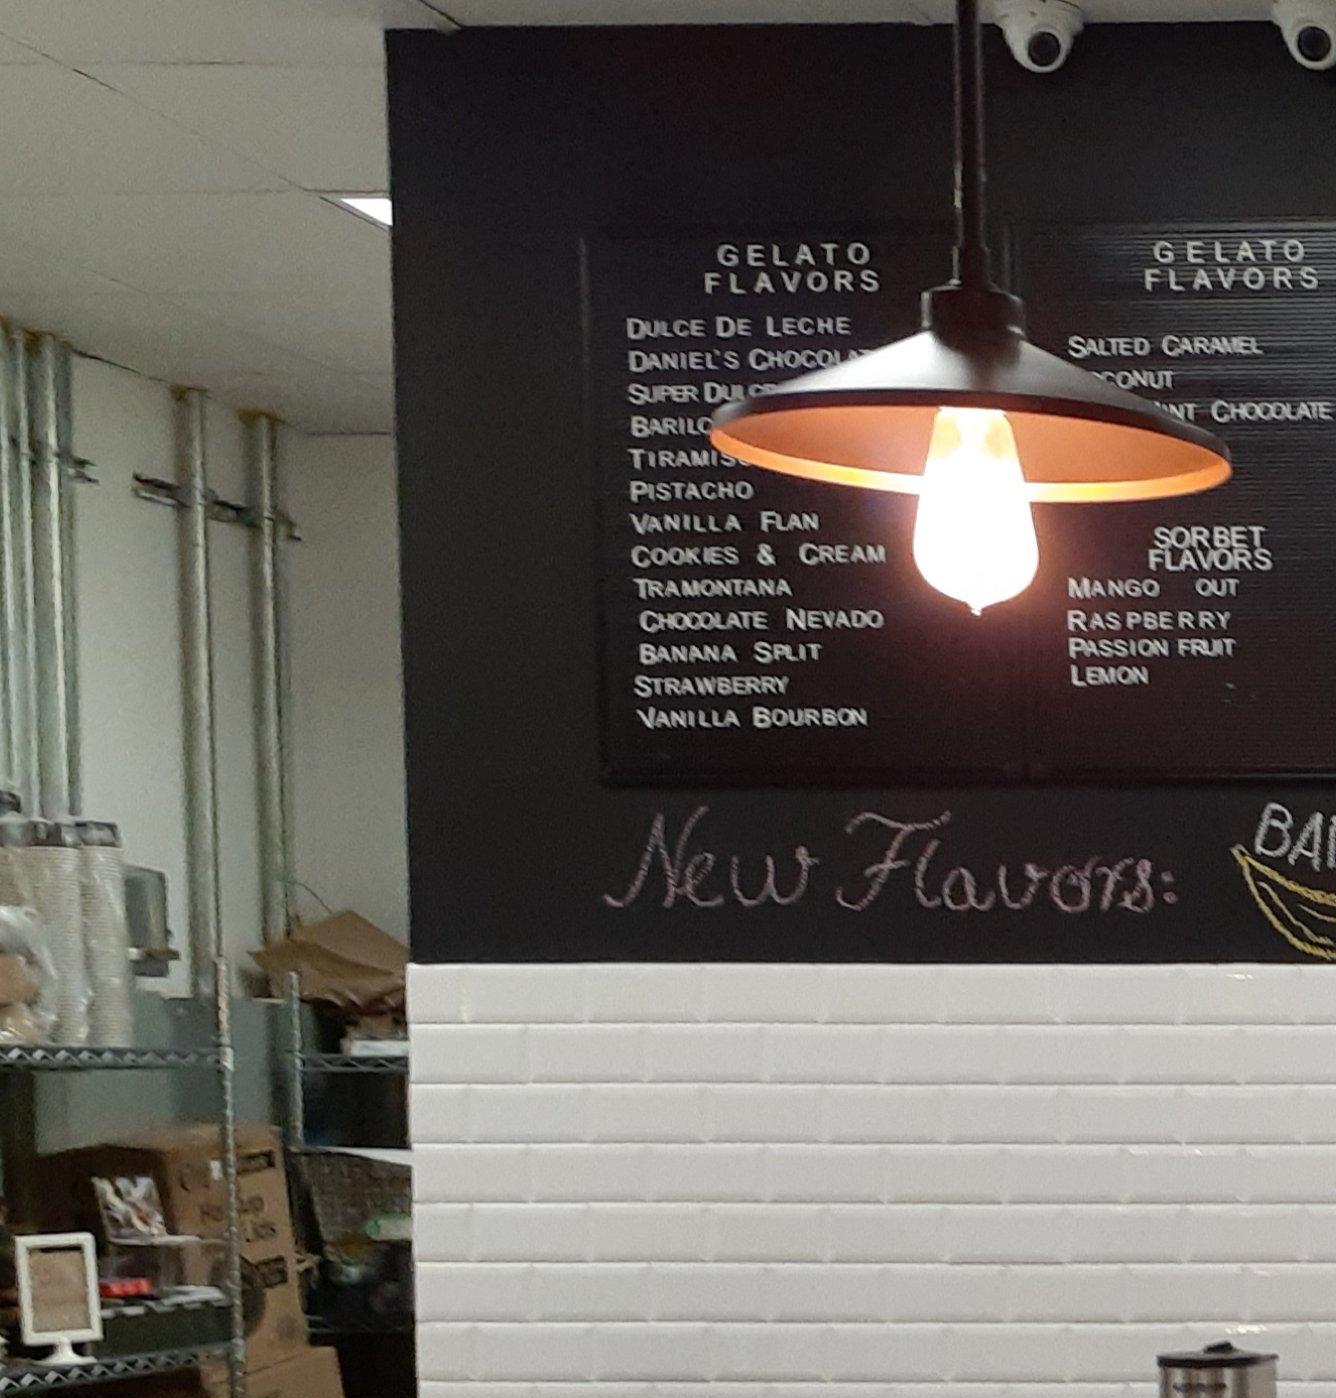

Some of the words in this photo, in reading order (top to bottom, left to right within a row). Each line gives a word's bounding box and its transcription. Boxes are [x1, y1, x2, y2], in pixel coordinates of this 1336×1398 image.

[717, 242, 871, 268] GELATO
[1153, 239, 1305, 264] GELATO
[704, 270, 880, 294] FLAVORS
[1144, 267, 1320, 293] FLAVORS
[627, 317, 705, 339] DULCE
[716, 317, 751, 337] DE
[766, 316, 851, 336] LECHE
[1069, 335, 1149, 358] SALTED
[1162, 335, 1263, 357] CARAMEL
[628, 349, 740, 373] DANIEL'S
[628, 383, 699, 405] SUPER
[1211, 400, 1334, 423] CHOCOLATE
[627, 449, 750, 470] TIRAMIS
[630, 480, 754, 503] PISTACHO
[629, 513, 742, 534] VANILLA
[760, 511, 820, 532] FLAN
[1152, 526, 1266, 550] SORBET
[631, 544, 740, 568] COOKIES
[756, 545, 776, 565] &
[799, 543, 886, 565] CREAM
[1148, 548, 1273, 572] FLAVORS
[633, 577, 793, 599] TRAMONTANA
[1067, 577, 1161, 600] MANGO
[1195, 577, 1240, 598] OUT
[639, 608, 768, 632] CHOCOLATE
[785, 608, 885, 630] NEVADO
[1067, 609, 1231, 632] RASPBERRY
[639, 641, 738, 664] BANANA
[753, 641, 822, 662] SPLIT
[1067, 637, 1170, 659] PASSION
[1177, 636, 1237, 657] FRUIT
[634, 675, 790, 698] STRAWBERRY
[1070, 664, 1150, 687] LEMON
[637, 707, 740, 730] VANILLA
[753, 706, 869, 728] BOURBON
[603, 805, 818, 912] New
